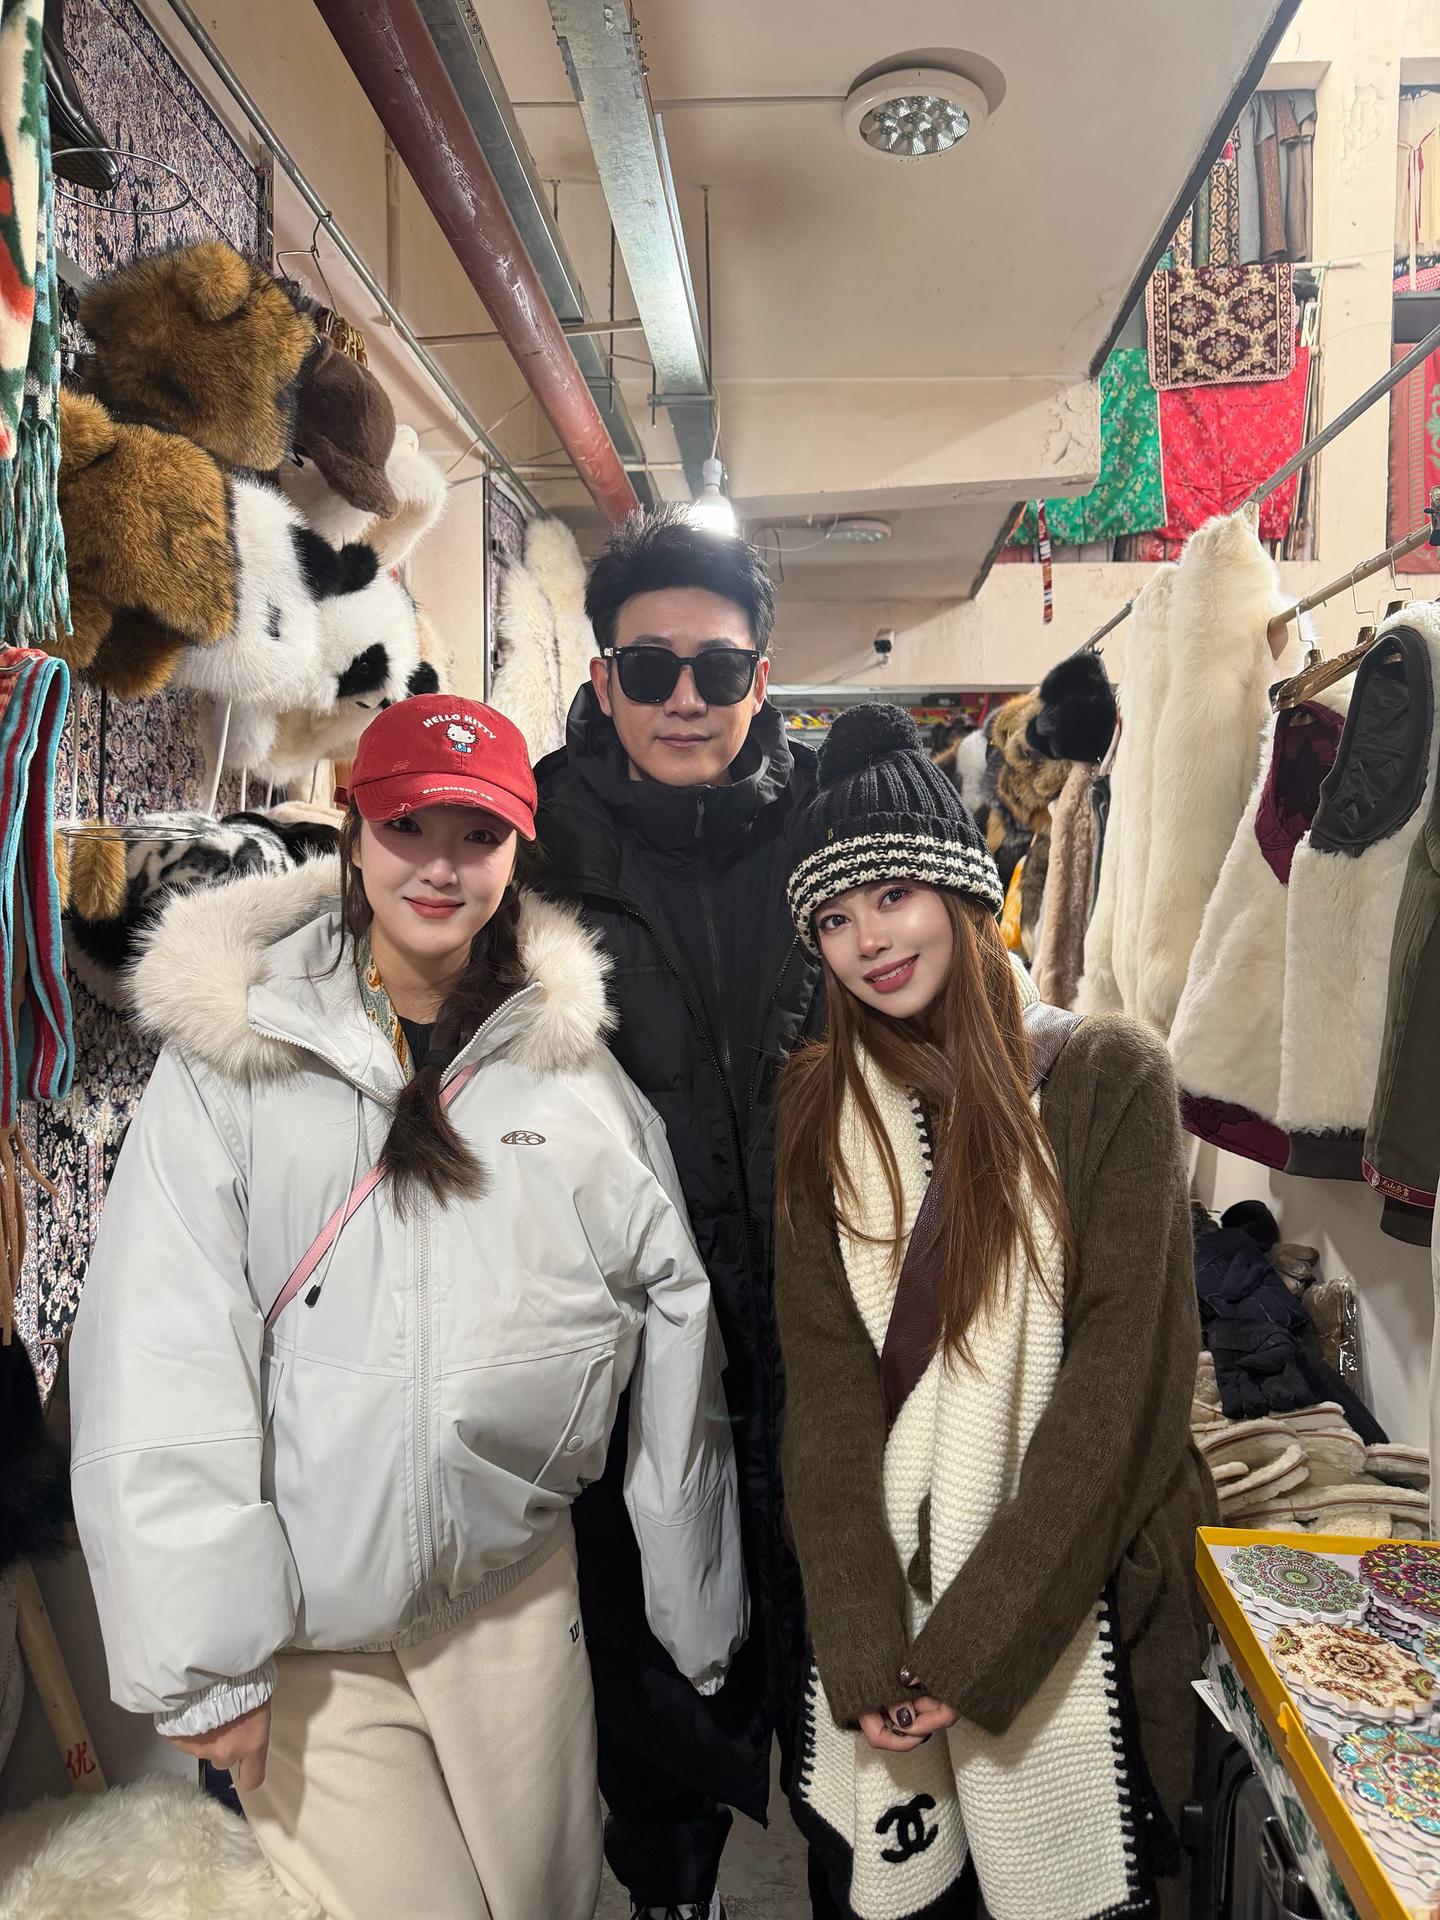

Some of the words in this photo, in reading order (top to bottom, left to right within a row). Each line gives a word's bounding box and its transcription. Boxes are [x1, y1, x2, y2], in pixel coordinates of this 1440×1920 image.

[422, 713, 461, 728] HELLO
[464, 715, 497, 739] KITTY
[66, 1741, 96, 1780] 优
